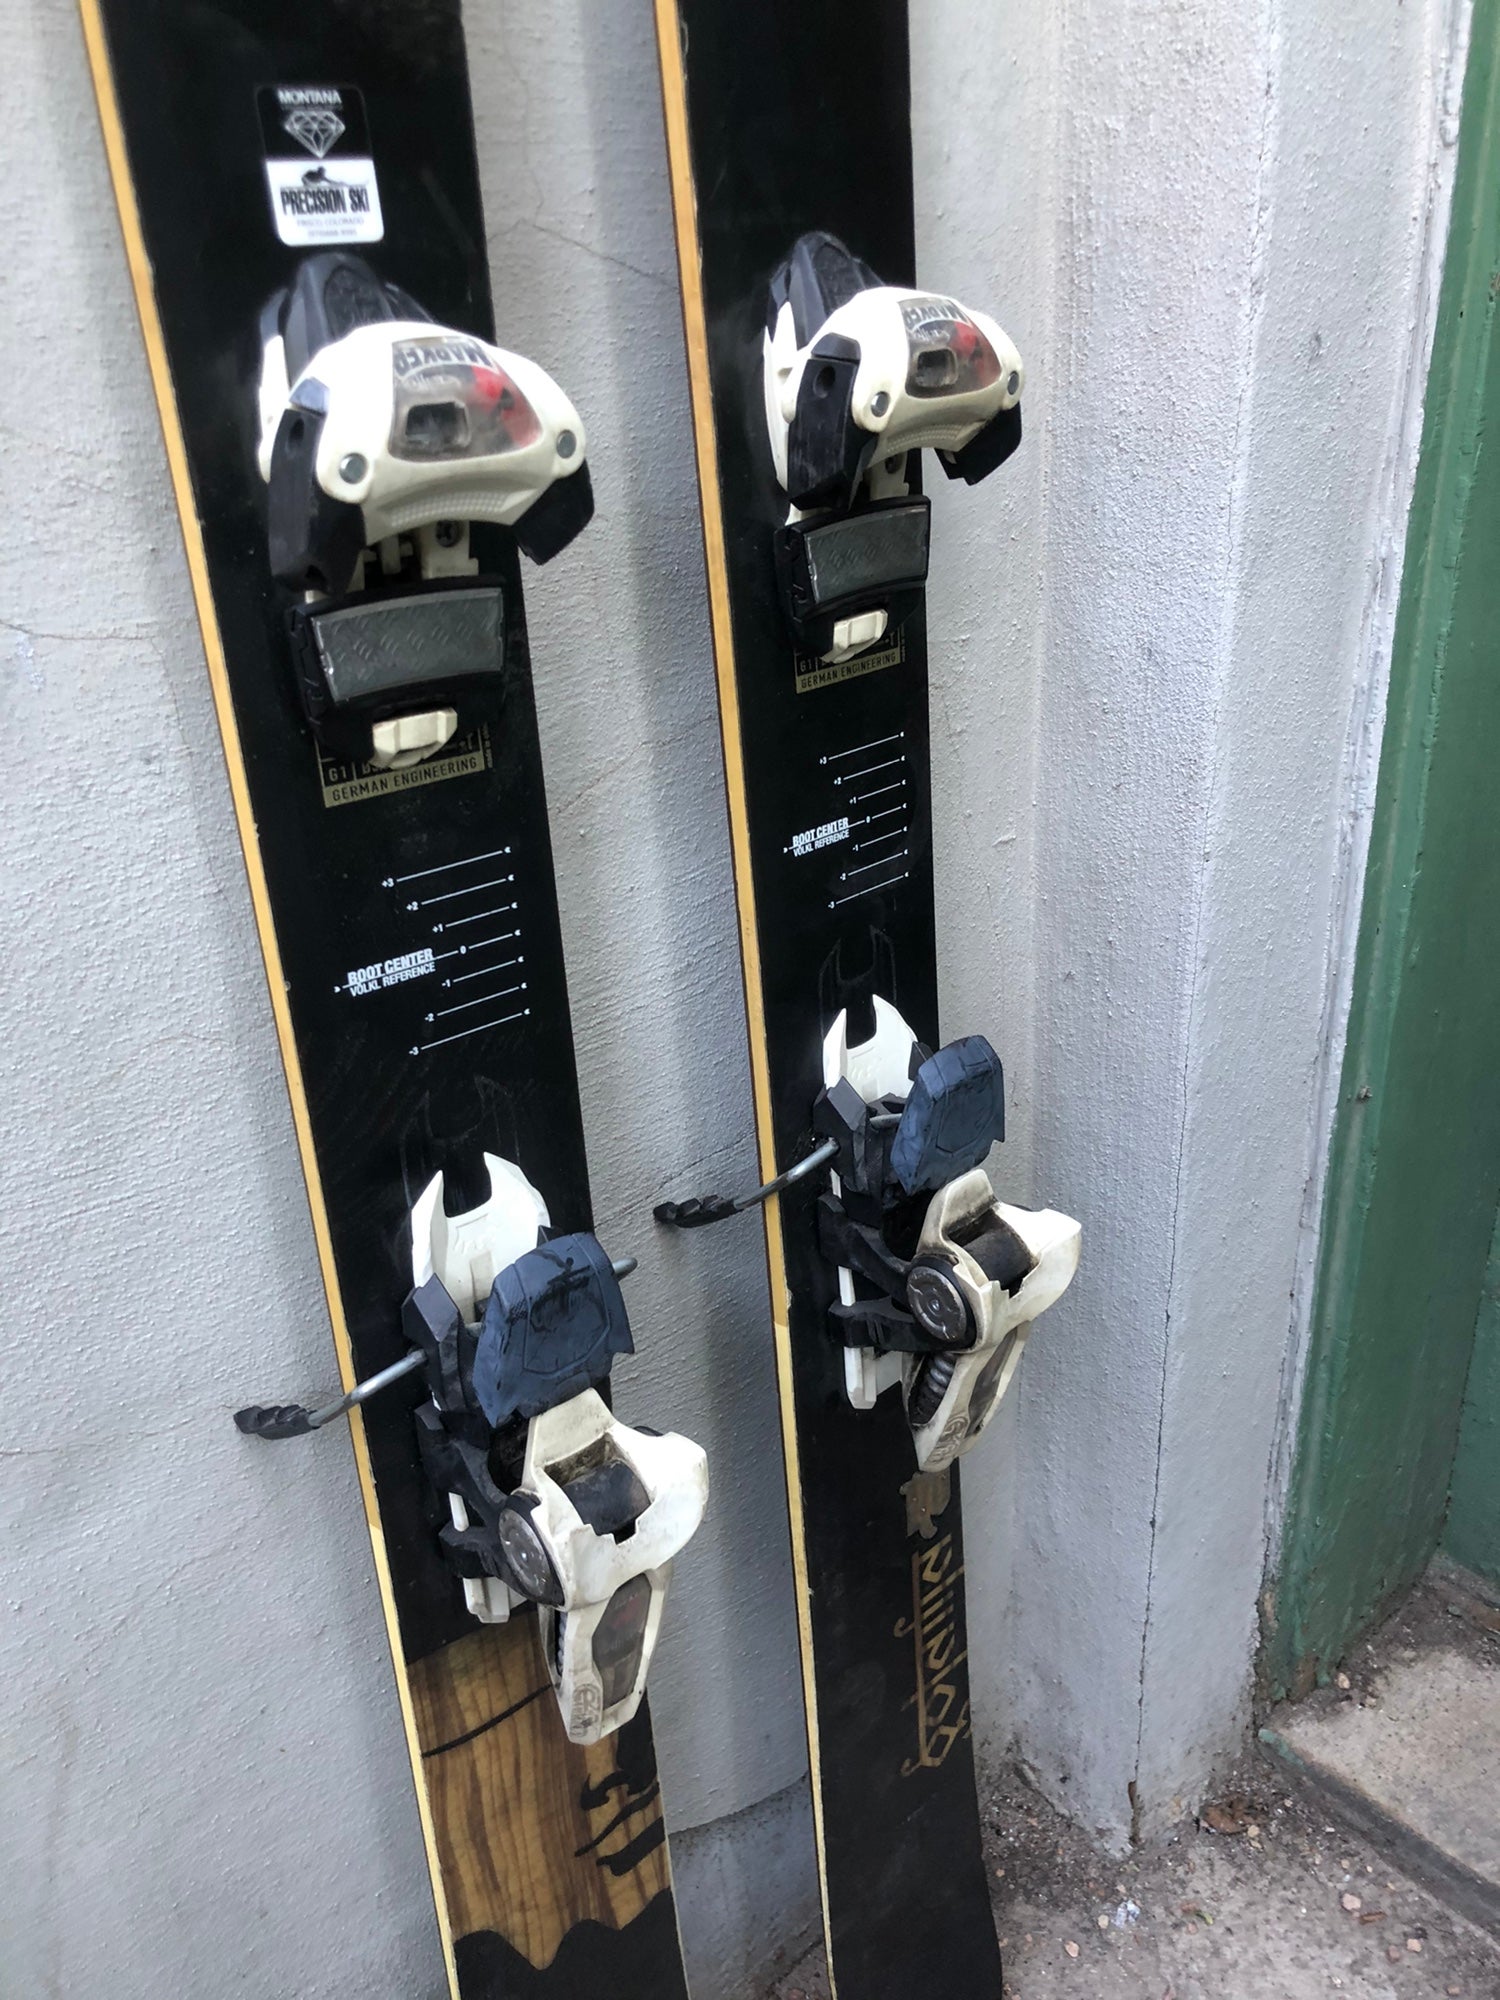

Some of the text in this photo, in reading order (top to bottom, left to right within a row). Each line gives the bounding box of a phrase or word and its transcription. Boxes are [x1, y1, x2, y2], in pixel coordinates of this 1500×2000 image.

[277, 88, 342, 105] MONTANA
[280, 184, 371, 216] PRECISION SKI
[902, 304, 968, 330] MARKER
[394, 340, 495, 376] MARKER
[801, 652, 896, 689] GERMAN ENGINEERING
[332, 757, 477, 802] GERMAN ENGINEERING
[792, 829, 816, 847] BOOT
[816, 817, 849, 839] CENTER
[814, 829, 850, 850] REFERENCE
[381, 877, 395, 888] +3
[406, 901, 420, 911] +2
[432, 923, 444, 933] +1
[347, 963, 386, 986] BOOT
[384, 948, 434, 975] CENTER
[382, 962, 436, 987] REFERENCE
[441, 979, 452, 988] -1
[424, 1013, 435, 1023] -2
[408, 1046, 419, 1056] -3
